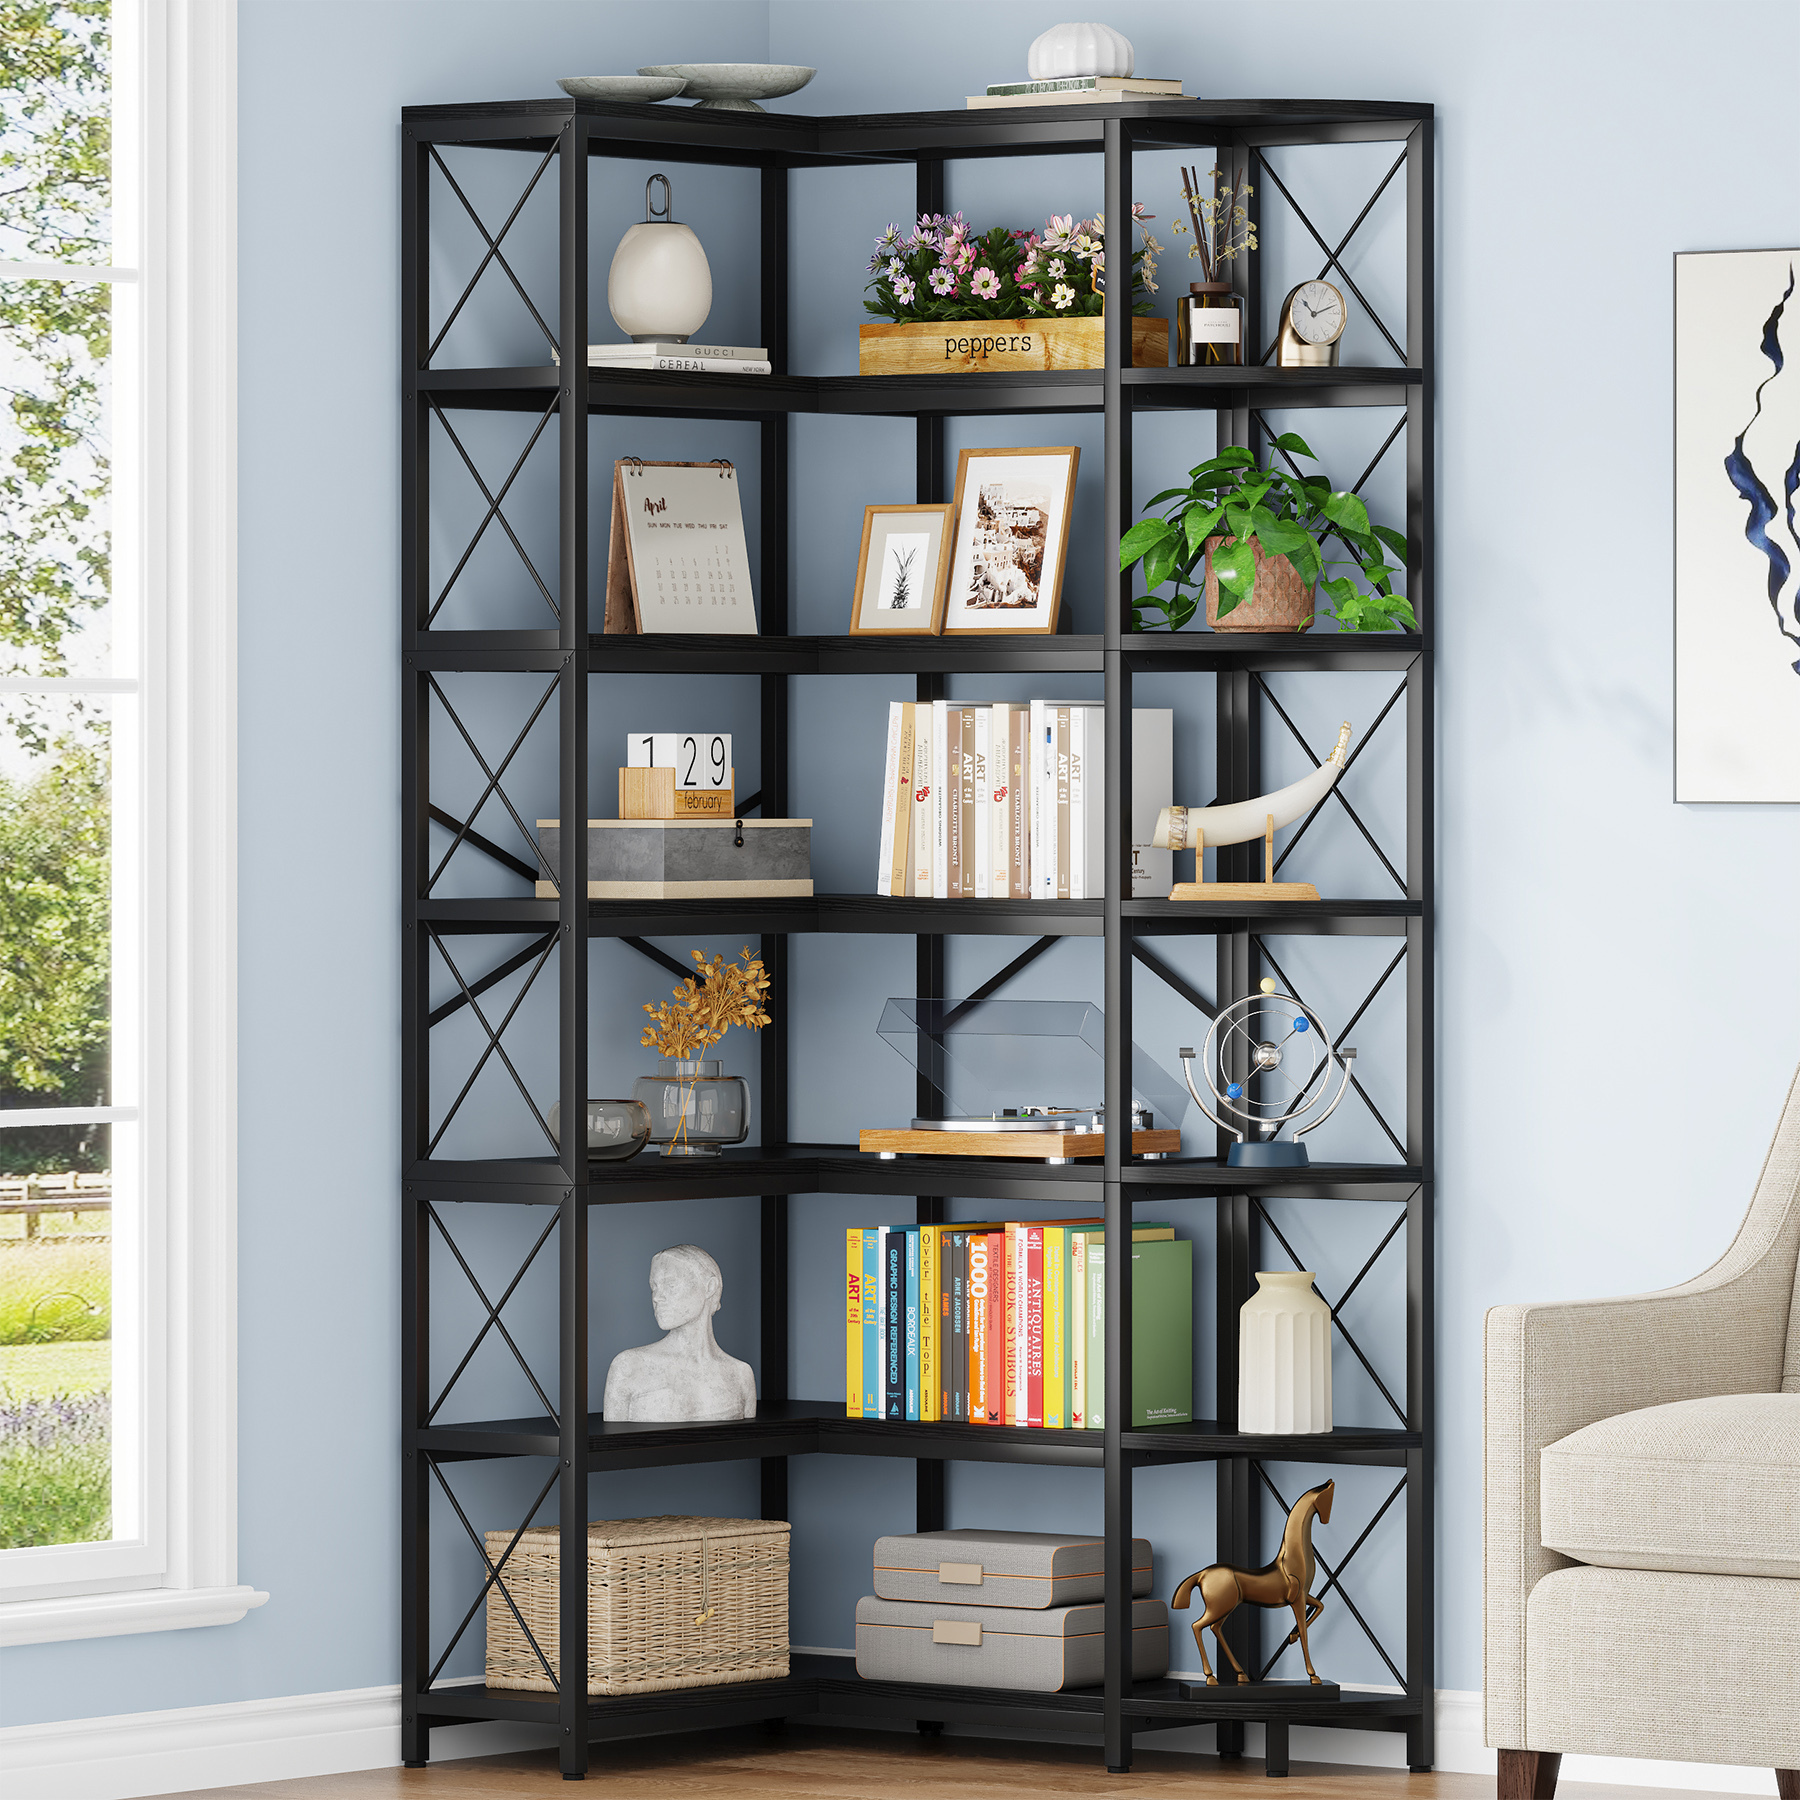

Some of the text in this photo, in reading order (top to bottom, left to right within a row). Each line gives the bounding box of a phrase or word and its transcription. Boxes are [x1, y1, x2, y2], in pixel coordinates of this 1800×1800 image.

[694, 347, 735, 357] GUCCI
[944, 335, 1032, 360] peppers
[659, 359, 706, 371] CEREAL
[643, 497, 668, 517] April
[963, 752, 973, 783] ART
[976, 753, 986, 783] ART
[1058, 752, 1068, 783] ART
[1072, 753, 1081, 783] ART
[684, 791, 723, 812] february
[890, 1248, 898, 1289] GRAPHIC
[922, 1233, 931, 1279] Over
[971, 1242, 988, 1298] 1000
[848, 1273, 860, 1303] ART
[864, 1273, 877, 1304] ART
[1006, 1271, 1016, 1312] BOOK
[1053, 1270, 1061, 1311] Contemporary
[890, 1290, 898, 1324] DESIGN
[954, 1296, 962, 1334] JACOBSEN
[907, 1306, 916, 1356] BORDEAUX
[1030, 1278, 1042, 1377] ANTIQUAIRES
[890, 1325, 898, 1385] REFERENCED
[922, 1336, 931, 1375] Top
[1006, 1326, 1017, 1398] SYMBOLS
